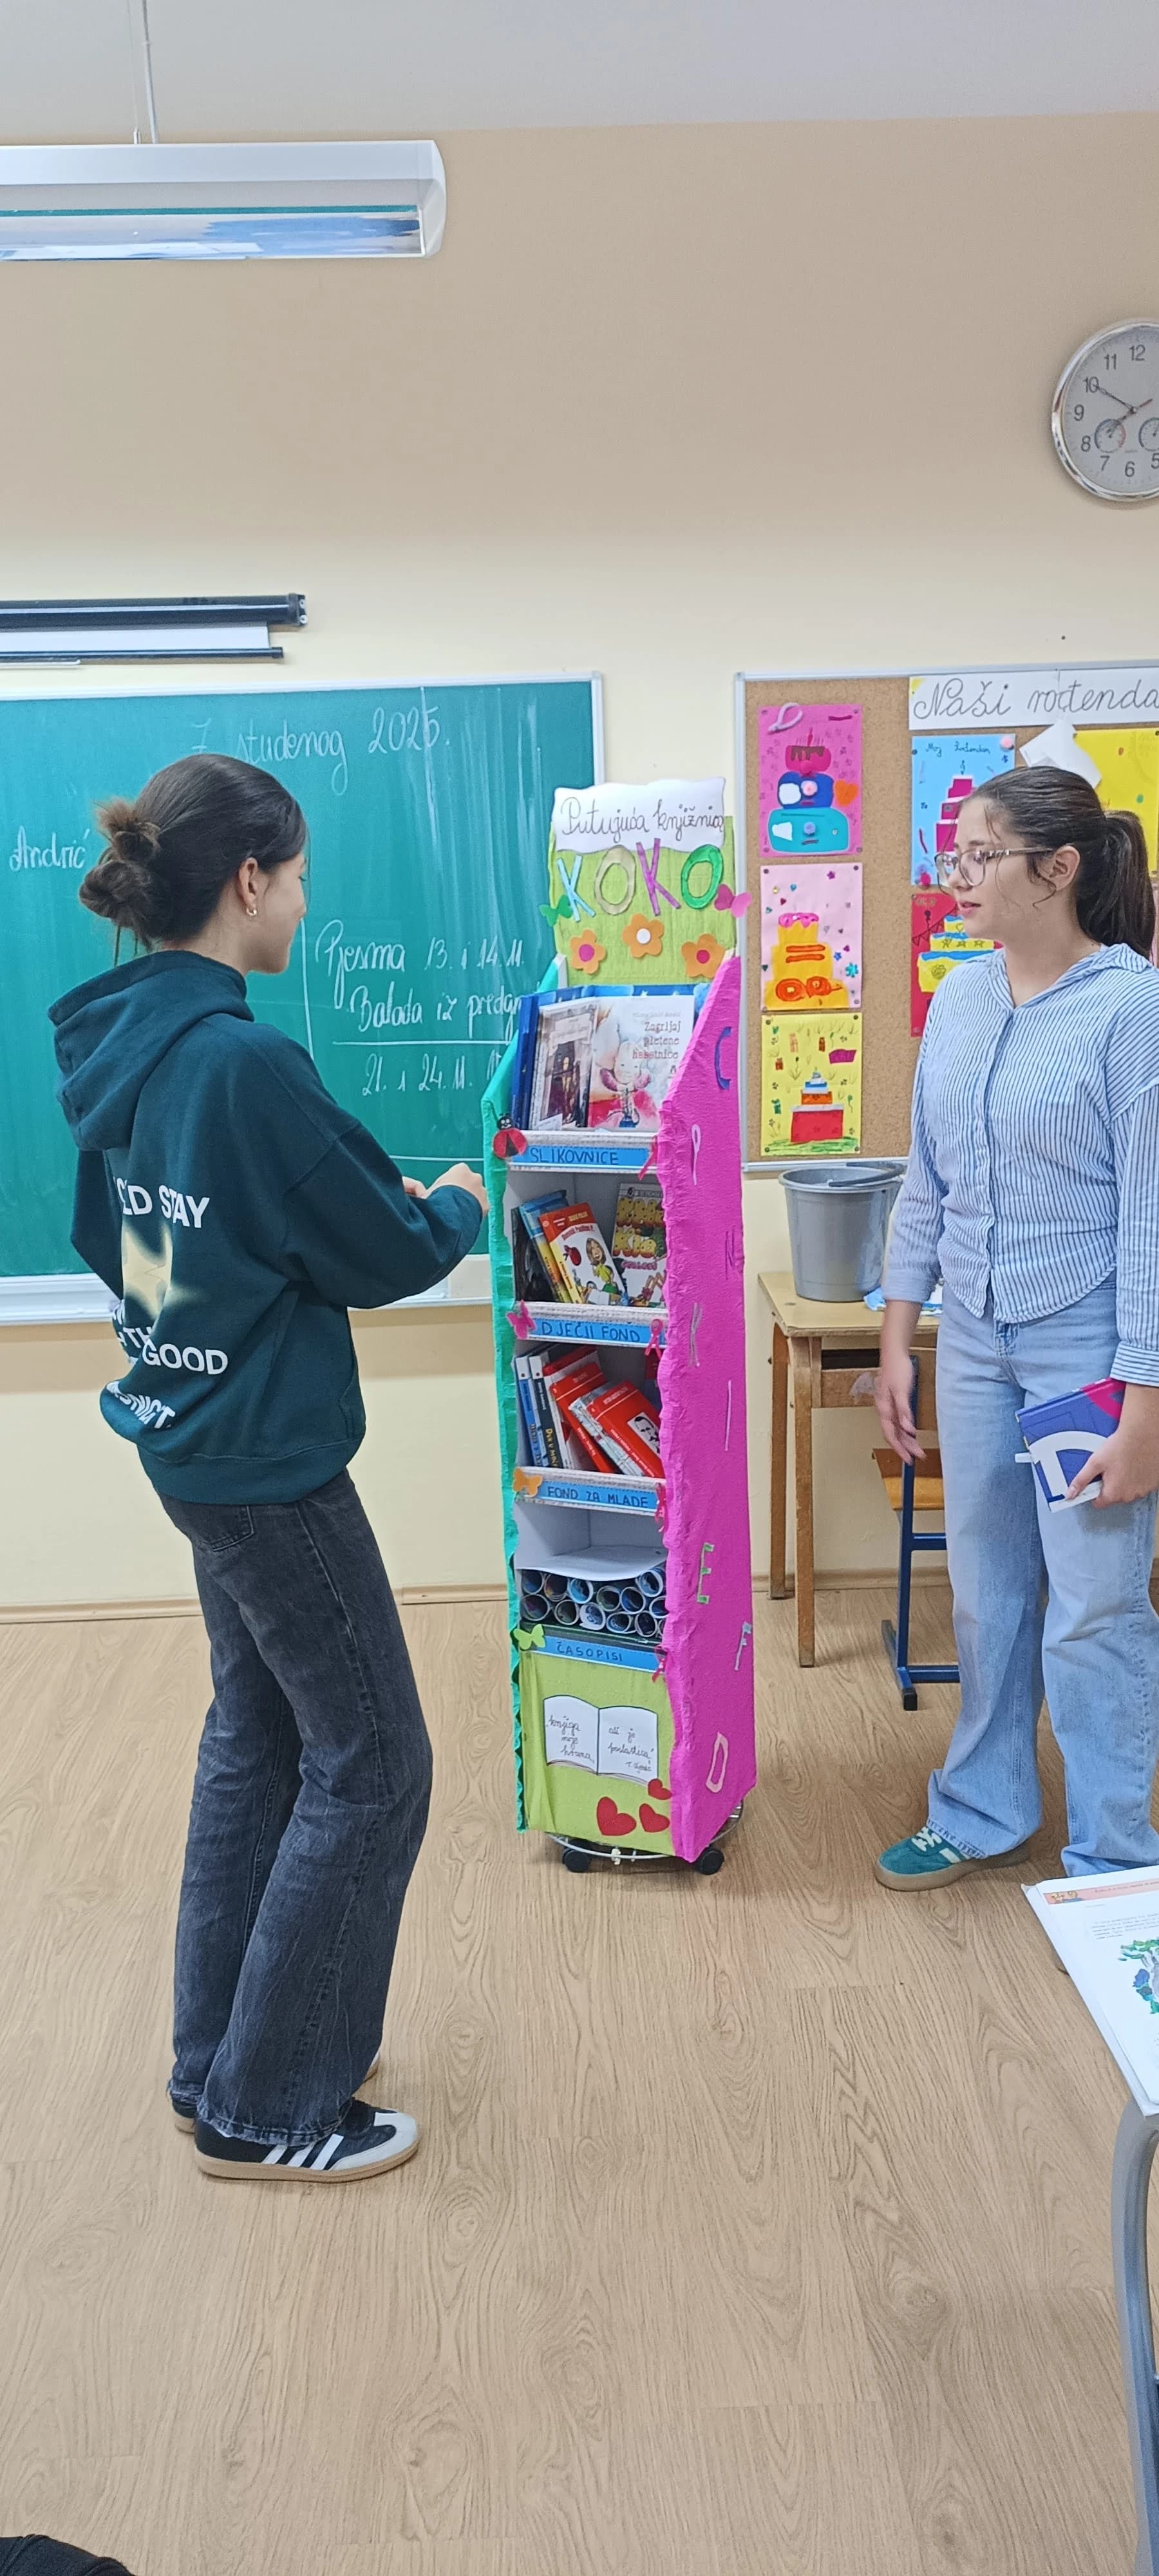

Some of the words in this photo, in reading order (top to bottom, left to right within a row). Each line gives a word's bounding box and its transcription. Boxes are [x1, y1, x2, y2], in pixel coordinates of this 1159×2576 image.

[1104, 354, 1117, 370] 11
[1129, 345, 1146, 361] 12
[1083, 376, 1099, 393] 10
[1073, 404, 1084, 421] 9
[1081, 435, 1091, 452] 8
[1100, 455, 1110, 471] 7
[1125, 461, 1135, 477] 6
[913, 677, 1011, 719] Naši
[236, 717, 348, 796] studenog
[560, 797, 650, 844] Putujuća
[652, 799, 725, 841] knjižnica
[9, 825, 90, 871] Andrić
[556, 837, 724, 922] KOKO
[315, 919, 405, 1010] Pjesma
[350, 981, 423, 1032] Balada
[530, 1147, 619, 1166] SLIKOVNICE
[158, 1185, 210, 1228] STAY
[601, 1325, 641, 1343] FOND
[142, 1339, 229, 1375] GOOD
[547, 1486, 578, 1500] FOND
[586, 1490, 601, 1502] ZA
[607, 1493, 648, 1508] MLADE
[556, 1640, 623, 1662] ČASOPISI
